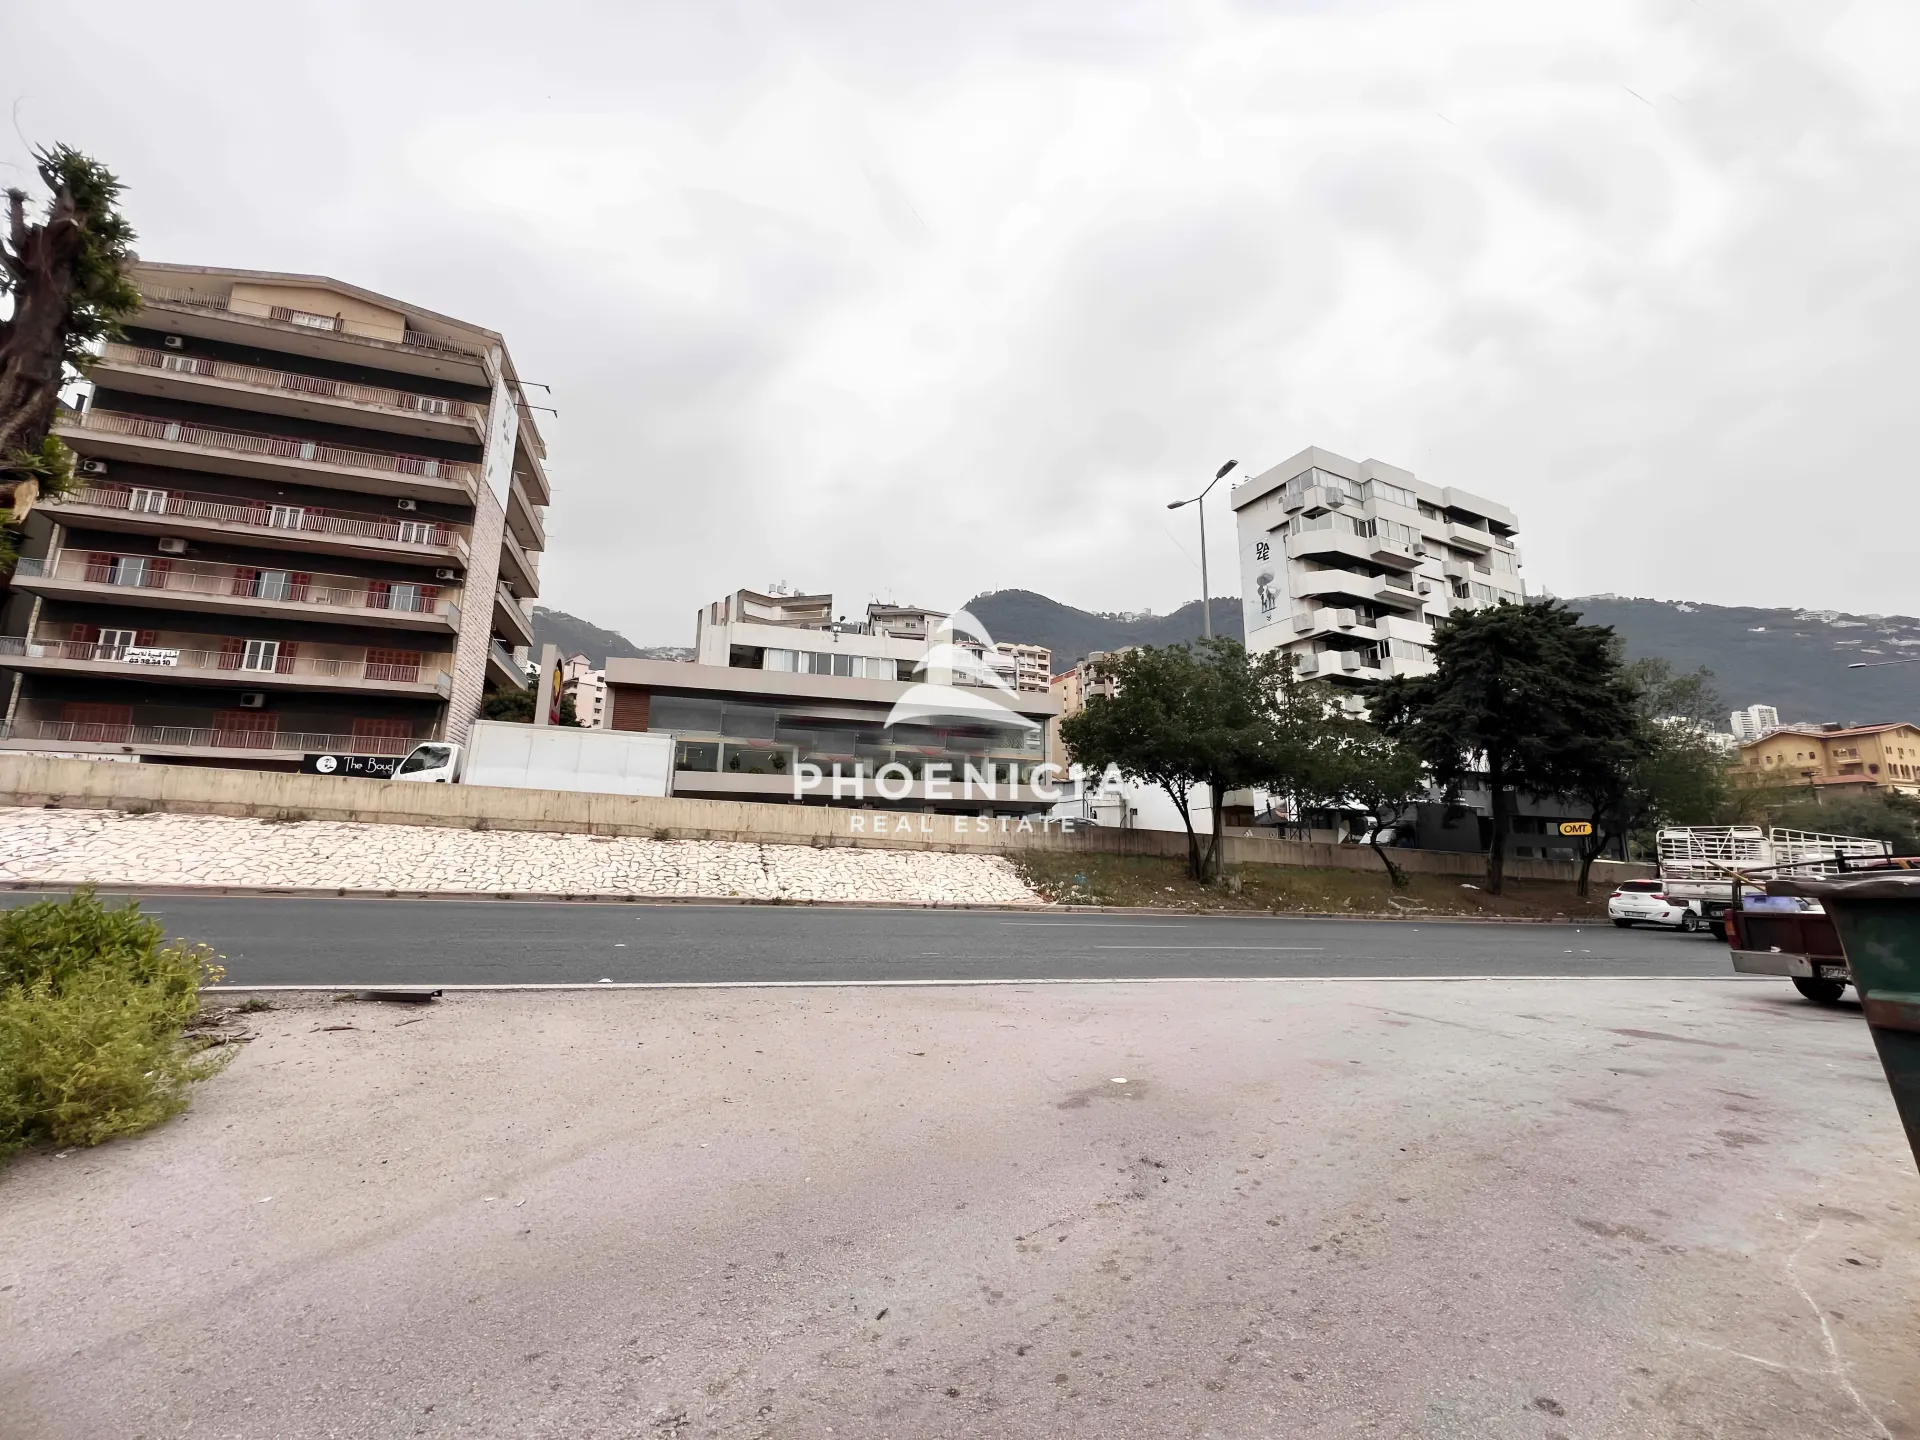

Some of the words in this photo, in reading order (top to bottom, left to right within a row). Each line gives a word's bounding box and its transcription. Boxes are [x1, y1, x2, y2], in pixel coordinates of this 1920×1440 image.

[344, 756, 363, 772] The
[365, 757, 395, 774] Boud
[1564, 824, 1588, 833] OMT
